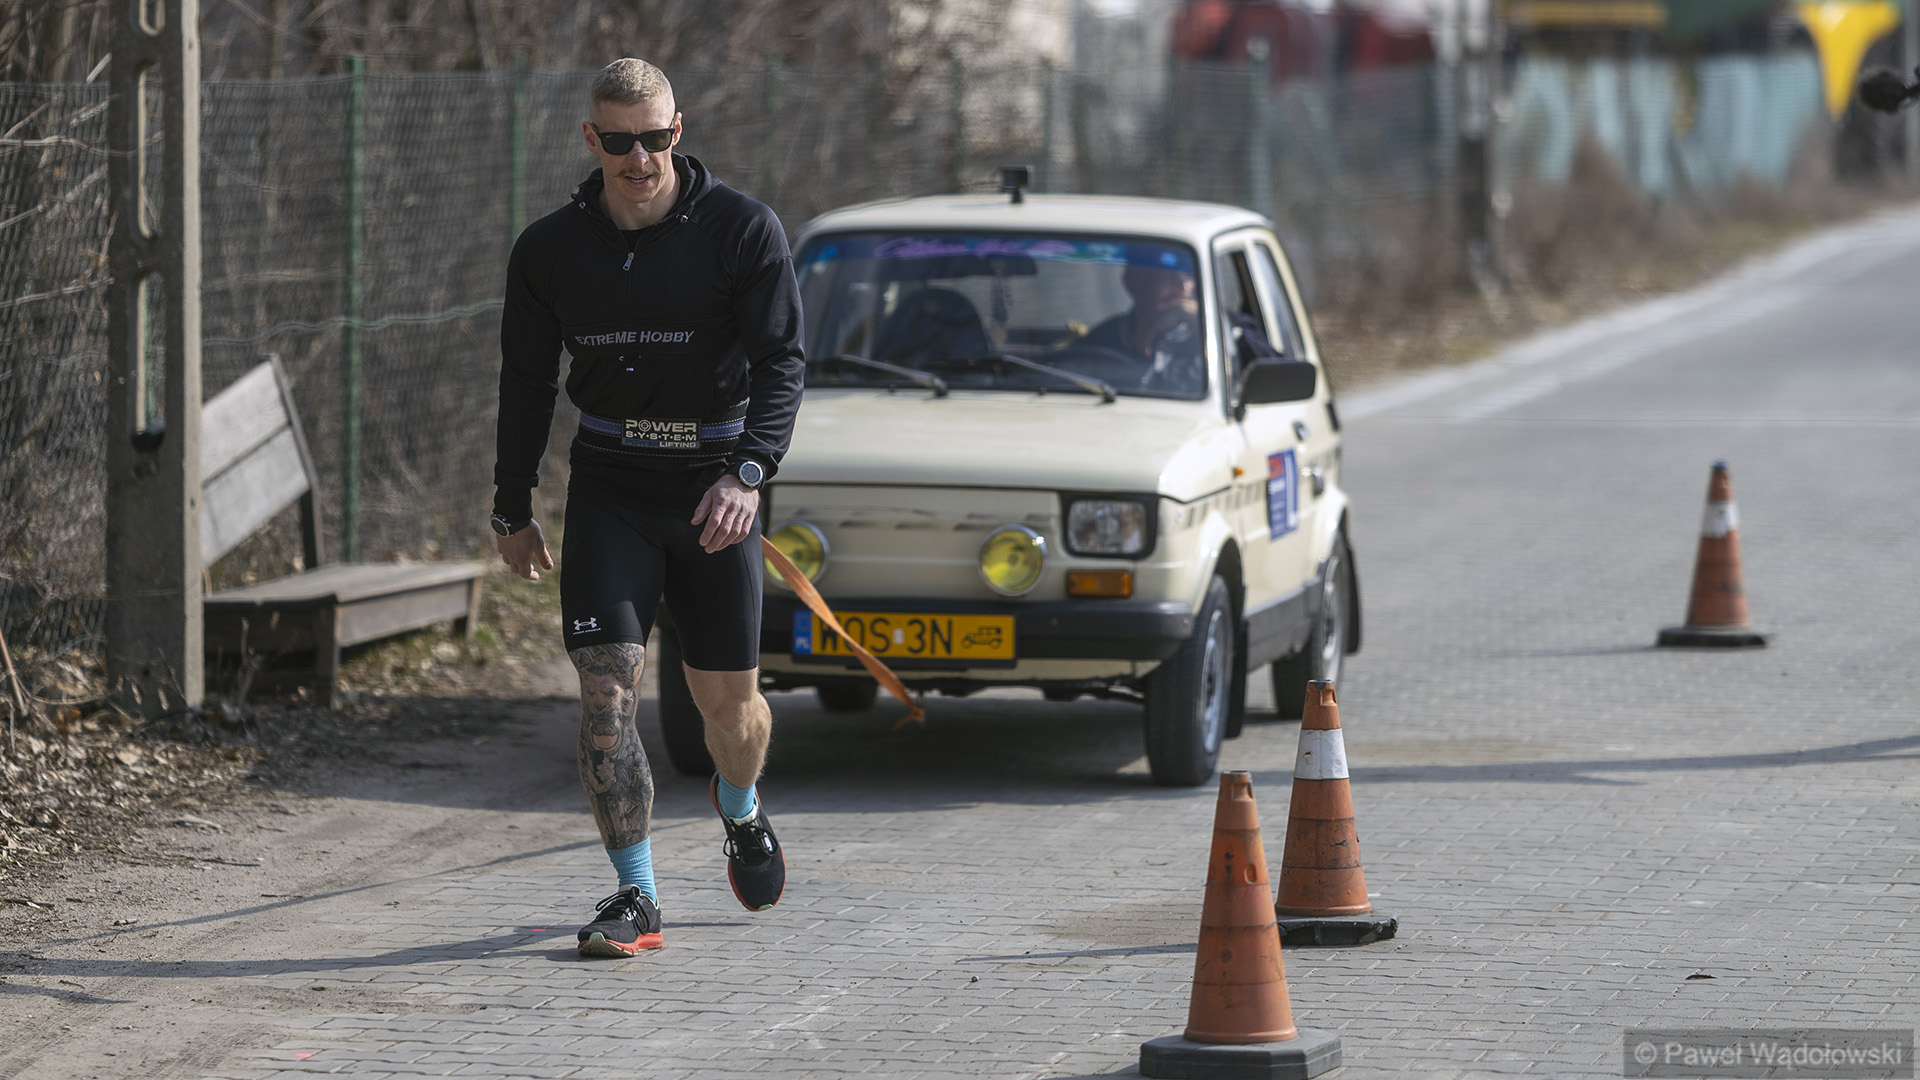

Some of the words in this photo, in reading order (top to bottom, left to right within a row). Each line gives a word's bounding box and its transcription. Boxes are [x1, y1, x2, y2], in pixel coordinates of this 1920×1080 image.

[575, 331, 637, 346] EXTREME
[639, 330, 694, 343] HOBBY
[625, 419, 697, 433] POWER
[659, 441, 697, 449] LIFTING
[820, 617, 891, 653] WOS
[908, 619, 952, 655] 3N
